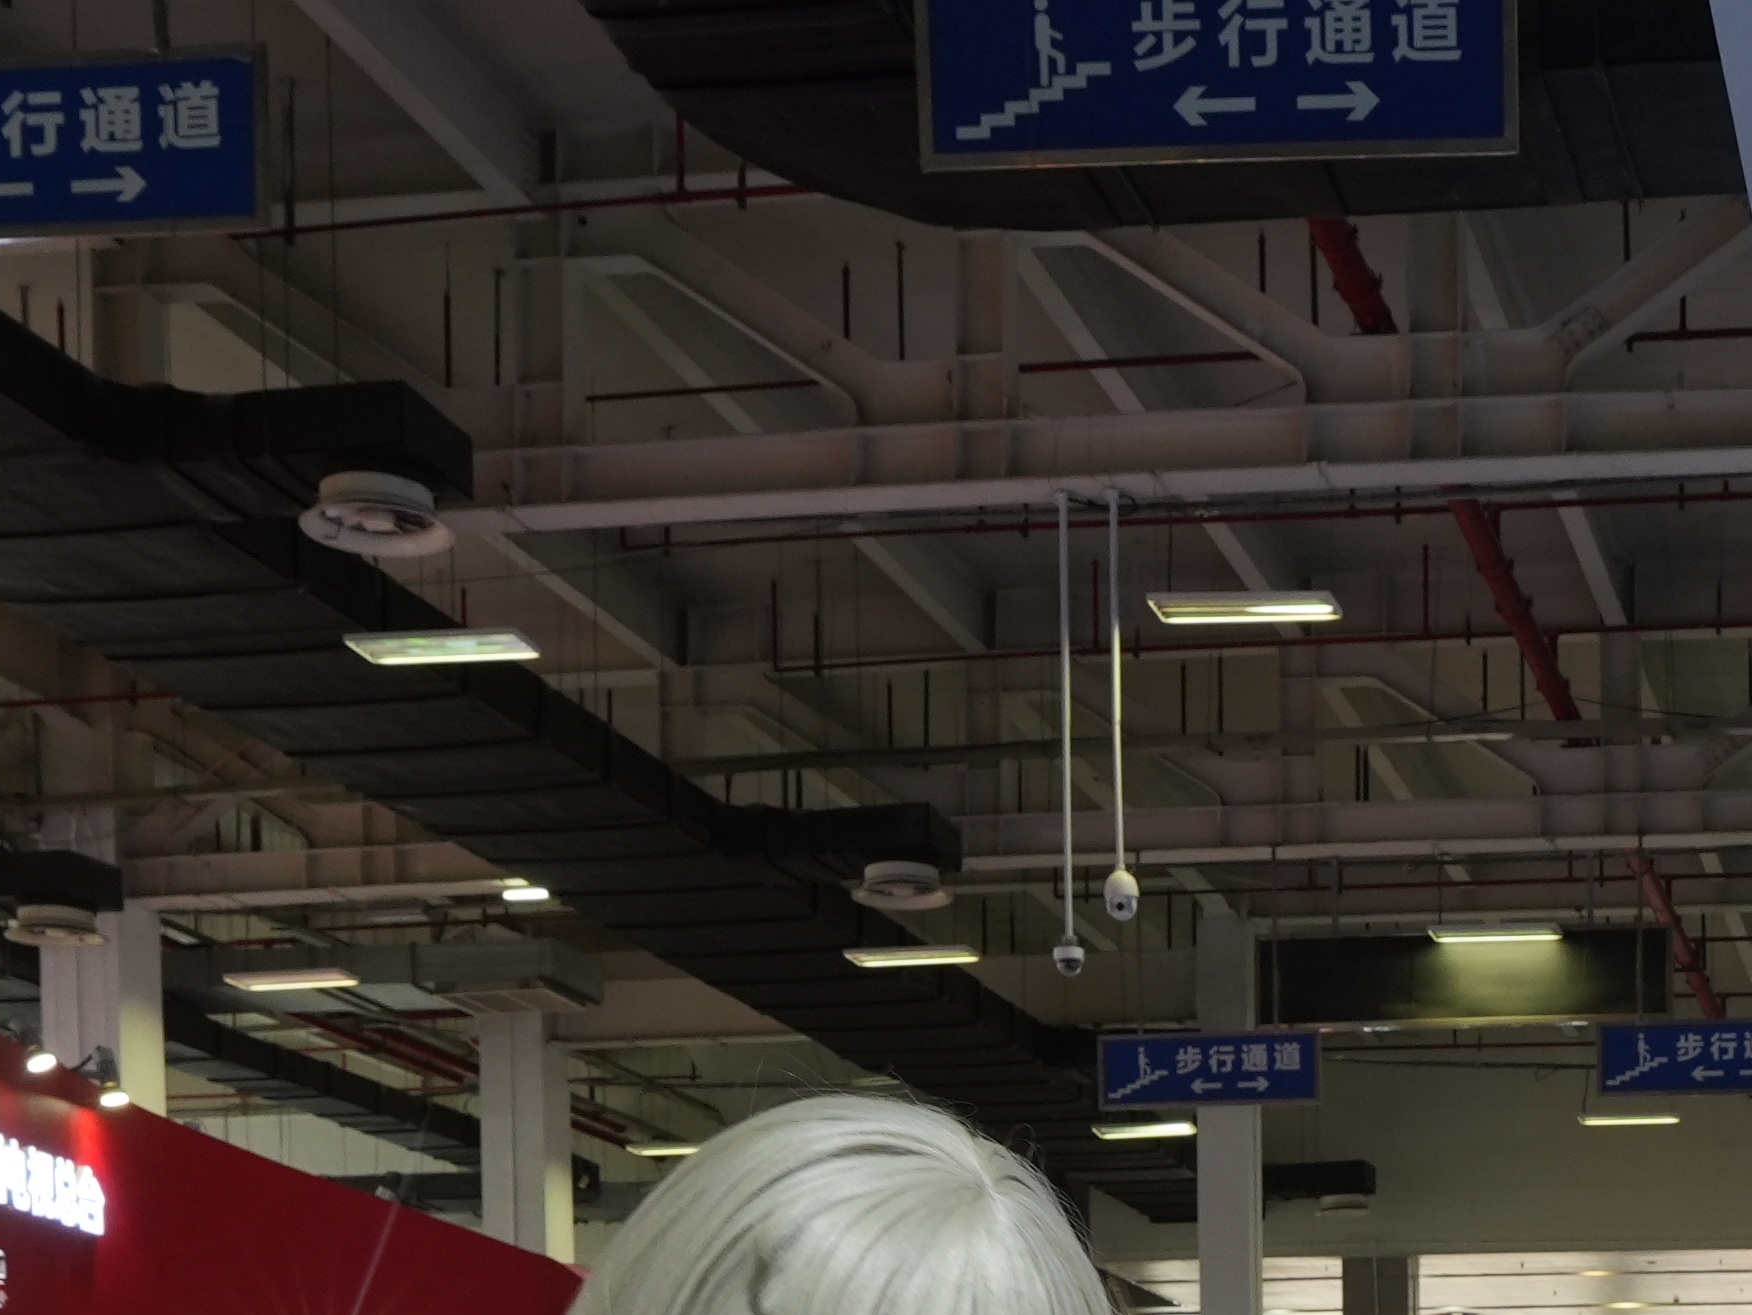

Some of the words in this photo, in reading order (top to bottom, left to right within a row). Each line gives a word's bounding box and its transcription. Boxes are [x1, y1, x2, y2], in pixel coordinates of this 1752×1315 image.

[1131, 0, 1465, 66] 步行通道
[1175, 1042, 1302, 1076] 步行通道
